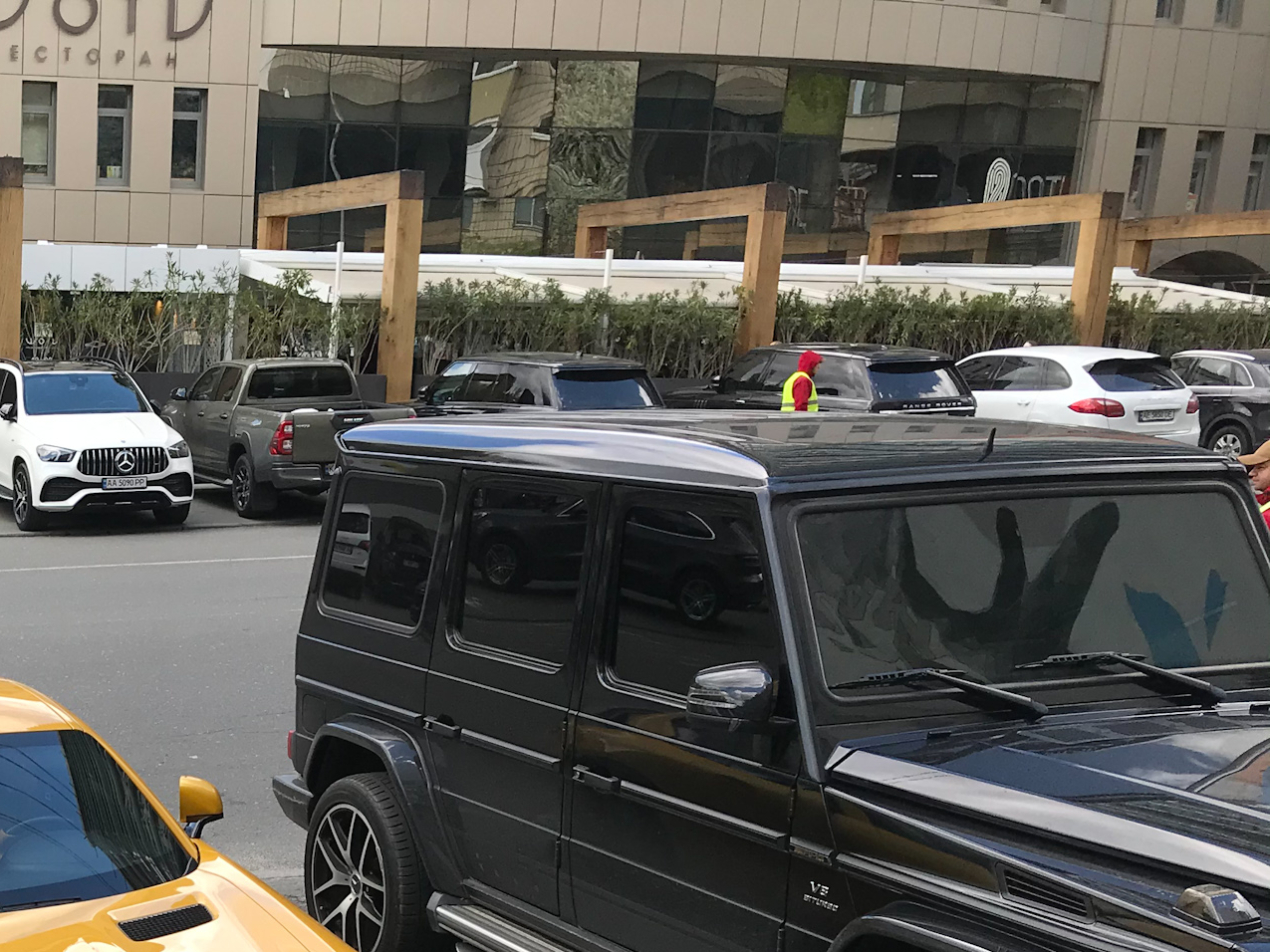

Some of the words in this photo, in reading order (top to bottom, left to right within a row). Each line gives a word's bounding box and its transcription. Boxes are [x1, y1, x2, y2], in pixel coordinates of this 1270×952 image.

[118, 479, 134, 487] 5090
[134, 478, 145, 486] PP
[810, 880, 830, 897] V8
[803, 893, 839, 912] BITURBO
